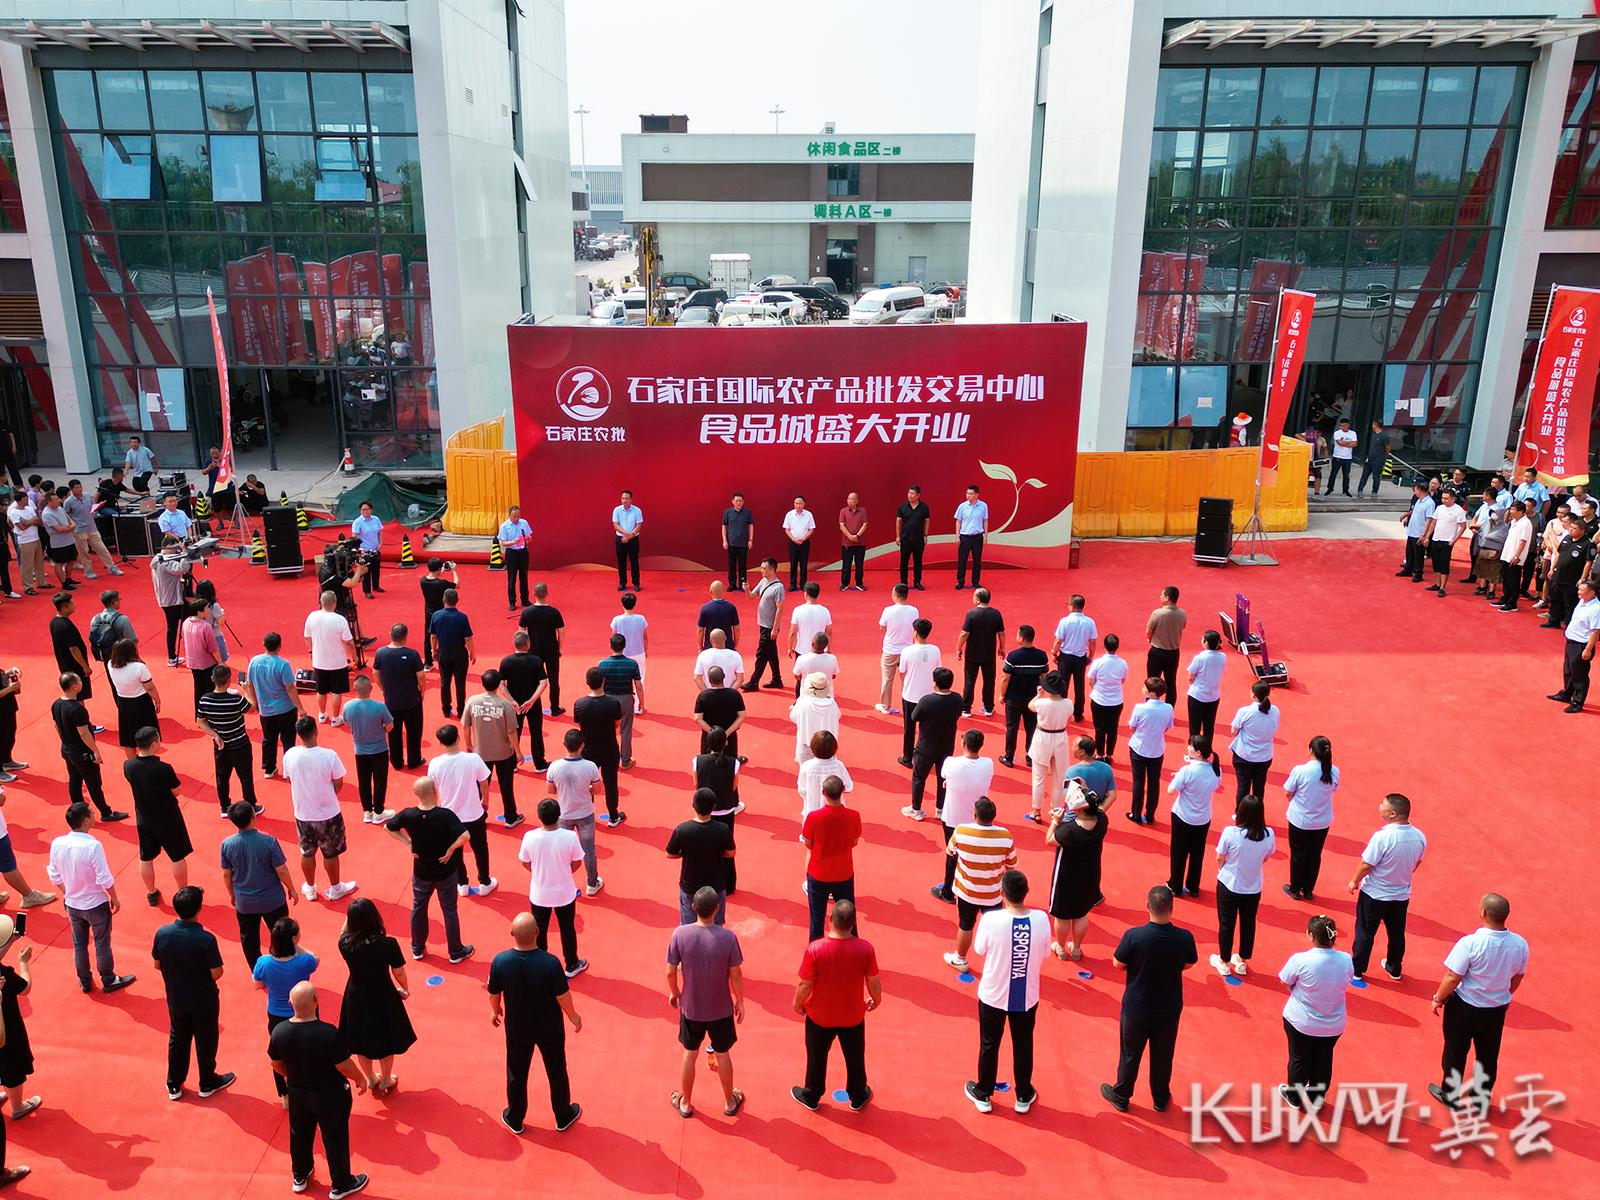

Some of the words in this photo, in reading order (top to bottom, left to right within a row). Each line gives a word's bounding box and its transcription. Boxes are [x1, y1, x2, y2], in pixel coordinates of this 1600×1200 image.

[627, 373, 1045, 405] 石家庄国际农产品批发交易中心
[545, 426, 626, 442] 石家庄农批
[700, 413, 970, 445] 食品城盛大开业
[1011, 931, 1030, 980] SPORTIVA
